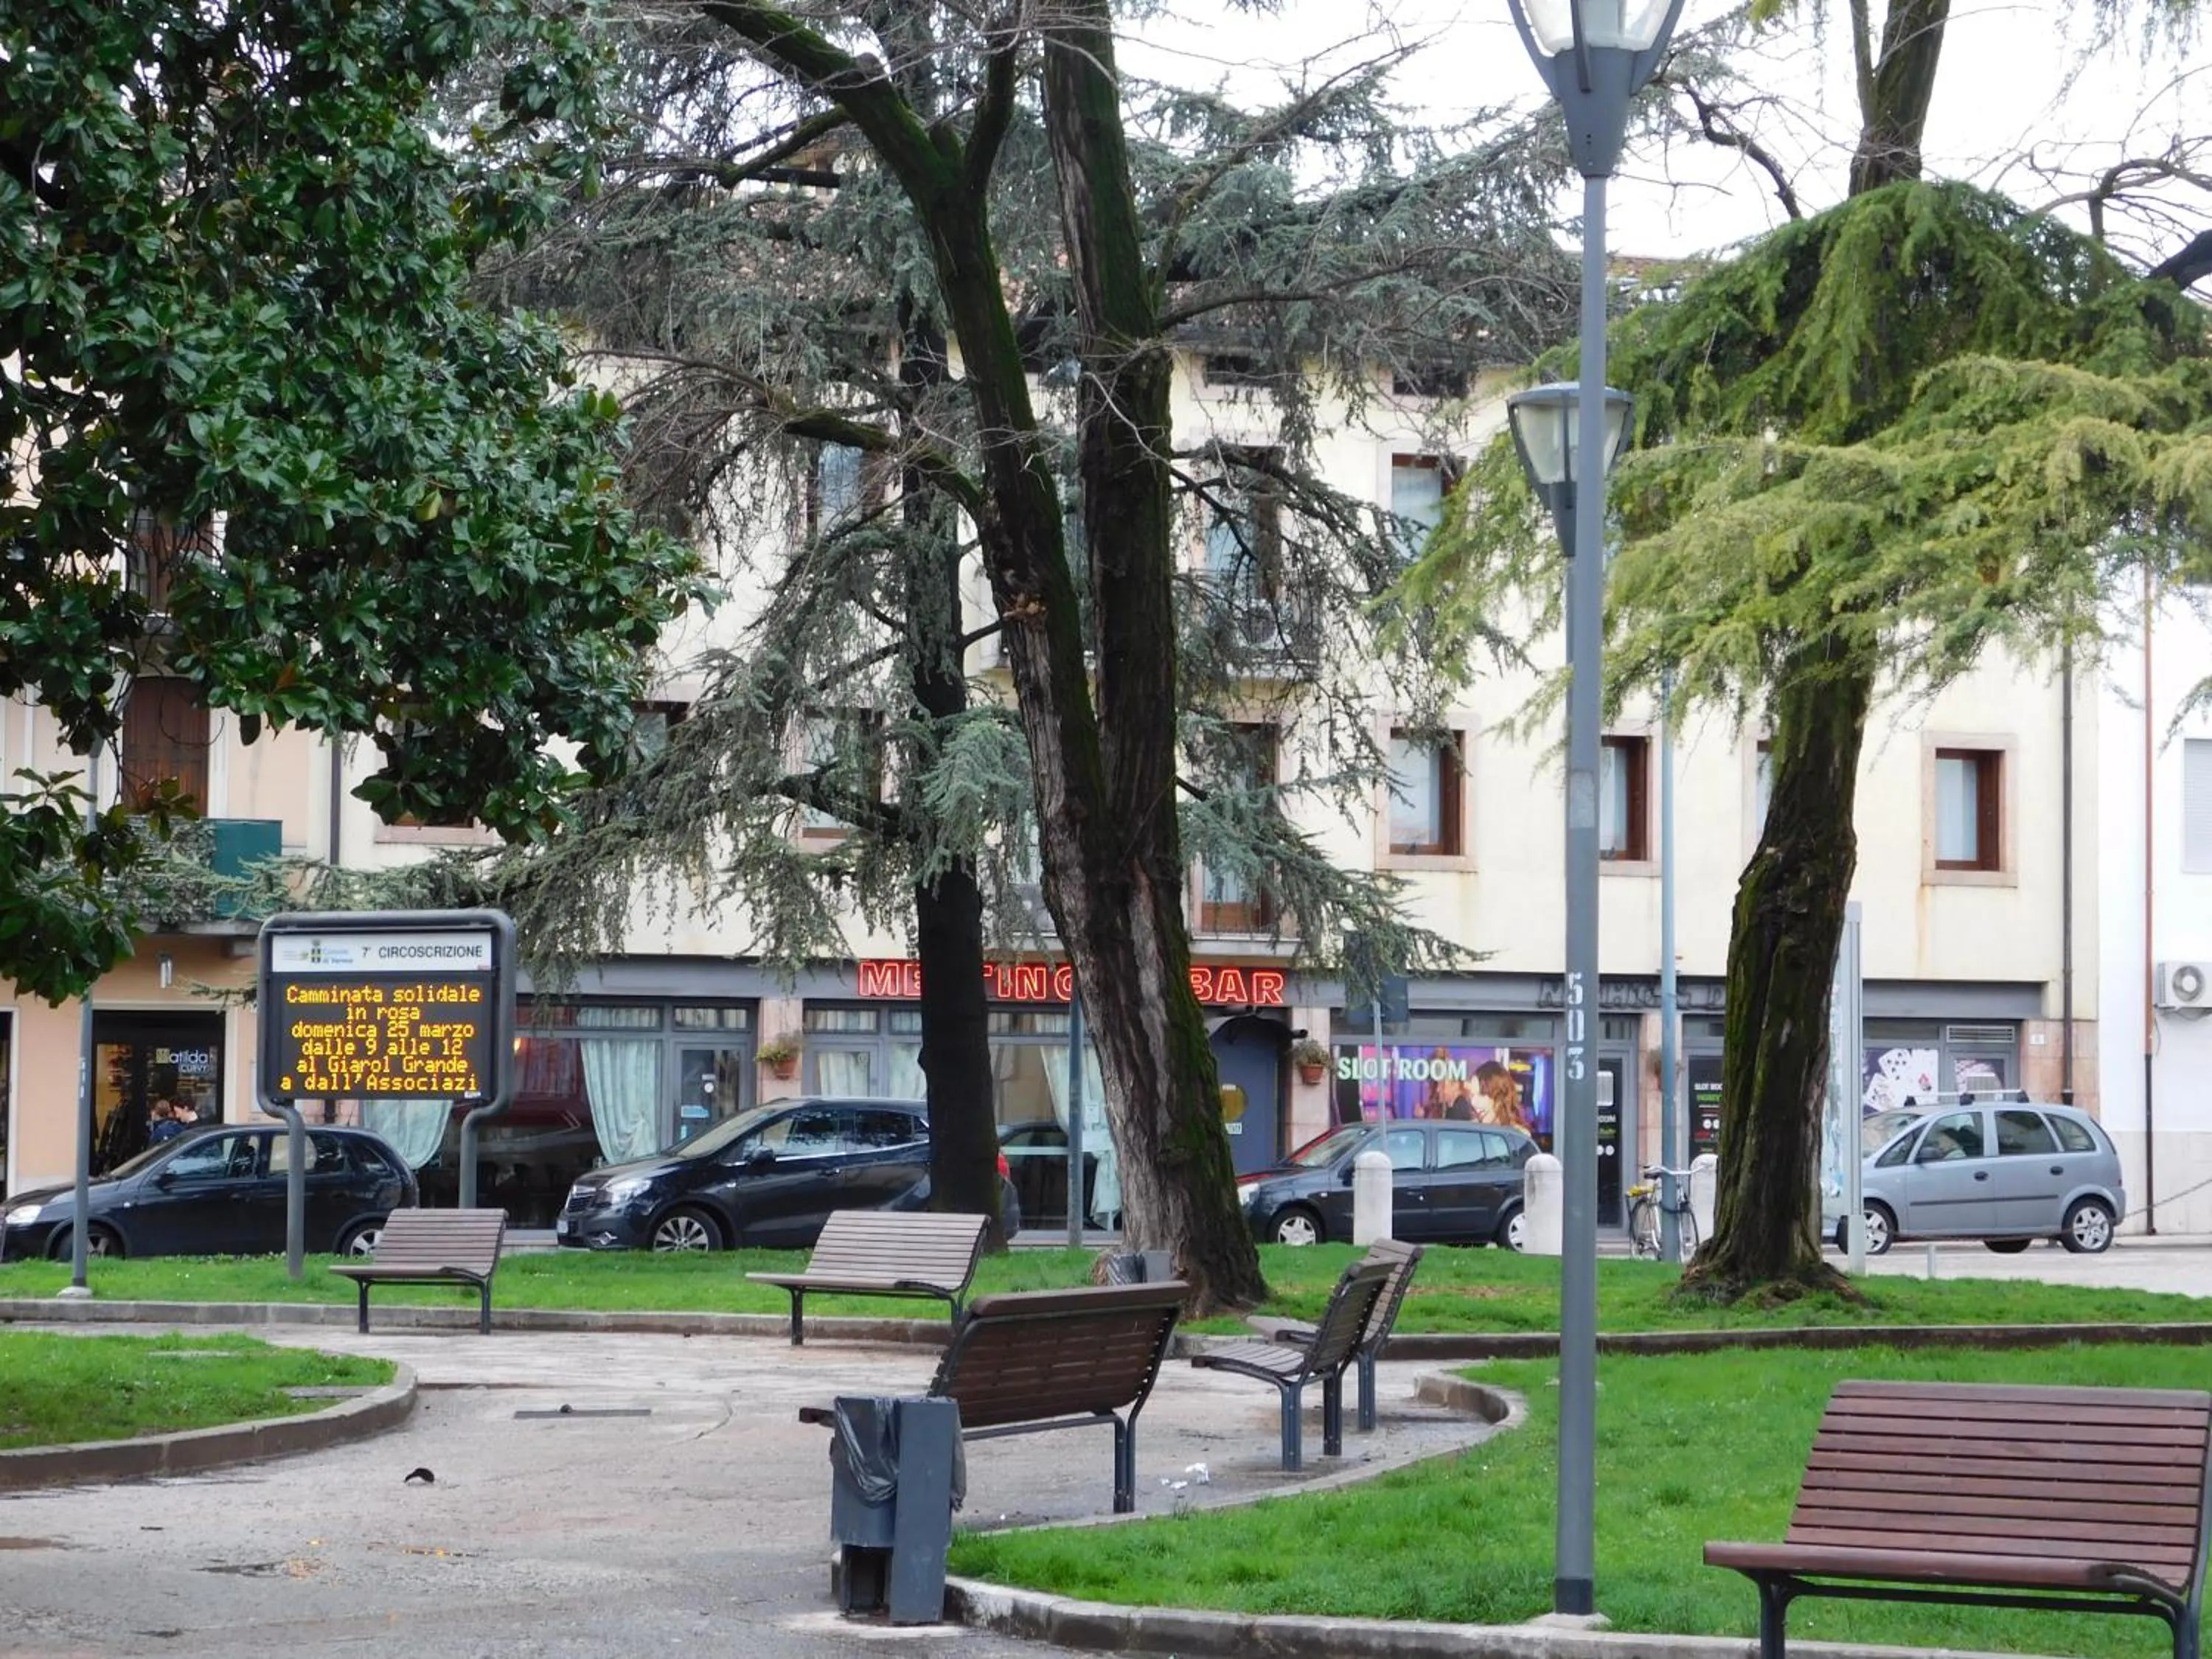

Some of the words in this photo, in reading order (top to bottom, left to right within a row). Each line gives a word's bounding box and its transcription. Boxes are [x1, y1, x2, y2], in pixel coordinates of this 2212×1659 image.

[378, 945, 484, 959] CIRCOSCRIZIONE
[859, 962, 1071, 1001] MEING
[1189, 967, 1285, 1004] BAR
[286, 984, 383, 1004] Camminata
[392, 984, 481, 1003] solidale
[346, 1003, 367, 1020] in
[376, 1006, 421, 1020] rosa
[291, 1020, 378, 1038] domenica
[386, 1020, 410, 1037] 25
[418, 1023, 475, 1038] marzo
[1567, 971, 1585, 1080] 503
[301, 1038, 355, 1055] dalle
[364, 1038, 378, 1055] 9
[386, 1038, 431, 1055] alle
[442, 1038, 463, 1055] 12
[296, 1056, 316, 1073] al
[327, 1056, 390, 1073] Giarol
[401, 1056, 468, 1074] Grande
[1338, 1057, 1392, 1080] SLOT
[1397, 1059, 1467, 1081] ROOM
[279, 1077, 291, 1091] a
